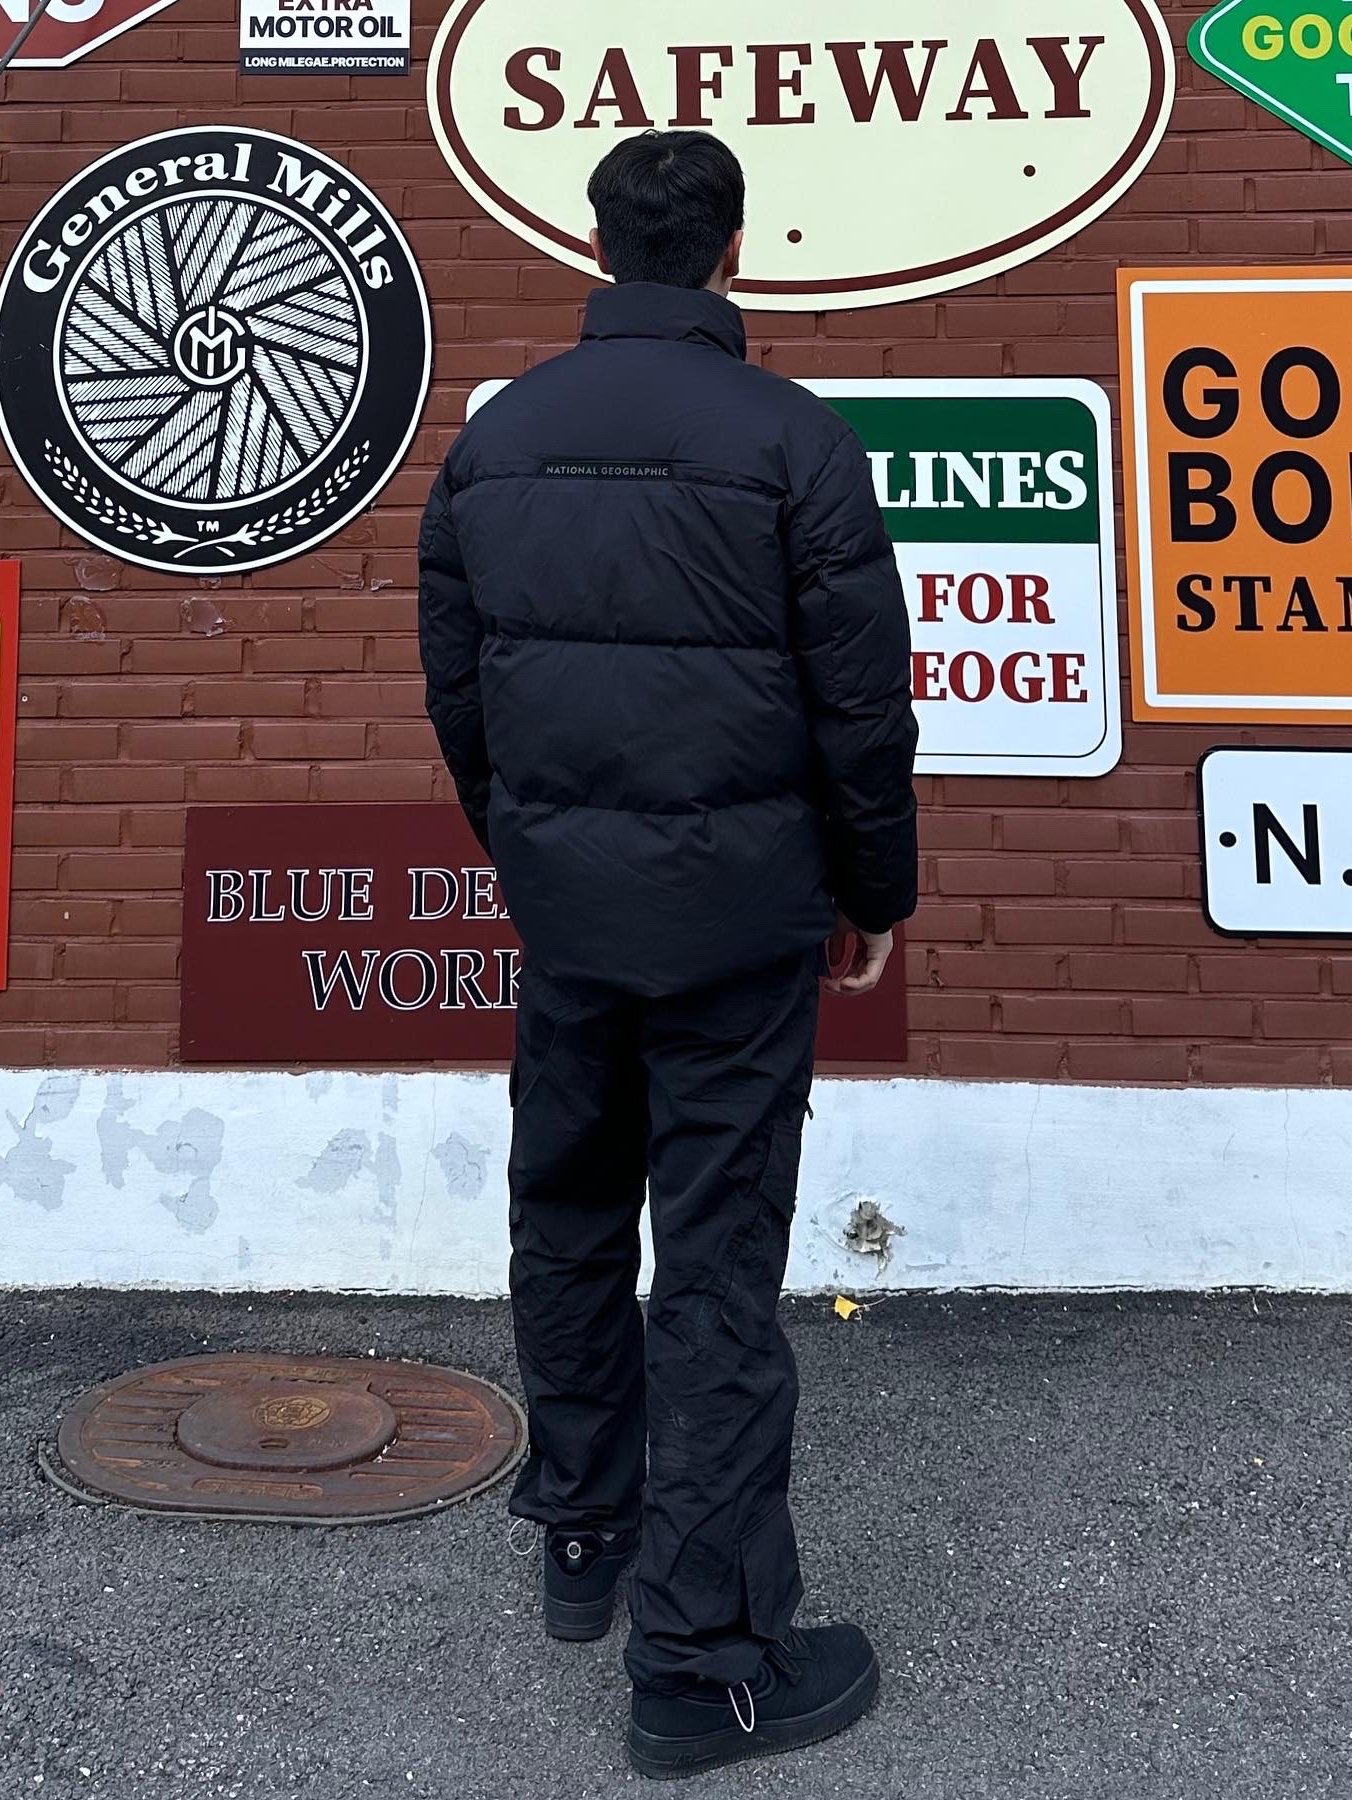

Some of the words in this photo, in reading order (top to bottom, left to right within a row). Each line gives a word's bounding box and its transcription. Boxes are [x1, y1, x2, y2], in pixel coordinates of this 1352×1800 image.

[250, 16, 353, 37] MOTOR
[359, 16, 401, 37] OIL
[246, 57, 277, 67] LONG
[503, 36, 1105, 131] SAFEWAY
[22, 143, 253, 293] General
[265, 151, 394, 290] Mills
[546, 466, 598, 475] NATIONAL
[601, 467, 669, 476] GEOGRAPHIC
[1168, 450, 1352, 544] BO
[197, 520, 220, 532] TM
[916, 573, 1056, 624] FOR
[206, 868, 374, 922] BLUE
[408, 867, 510, 920] DE
